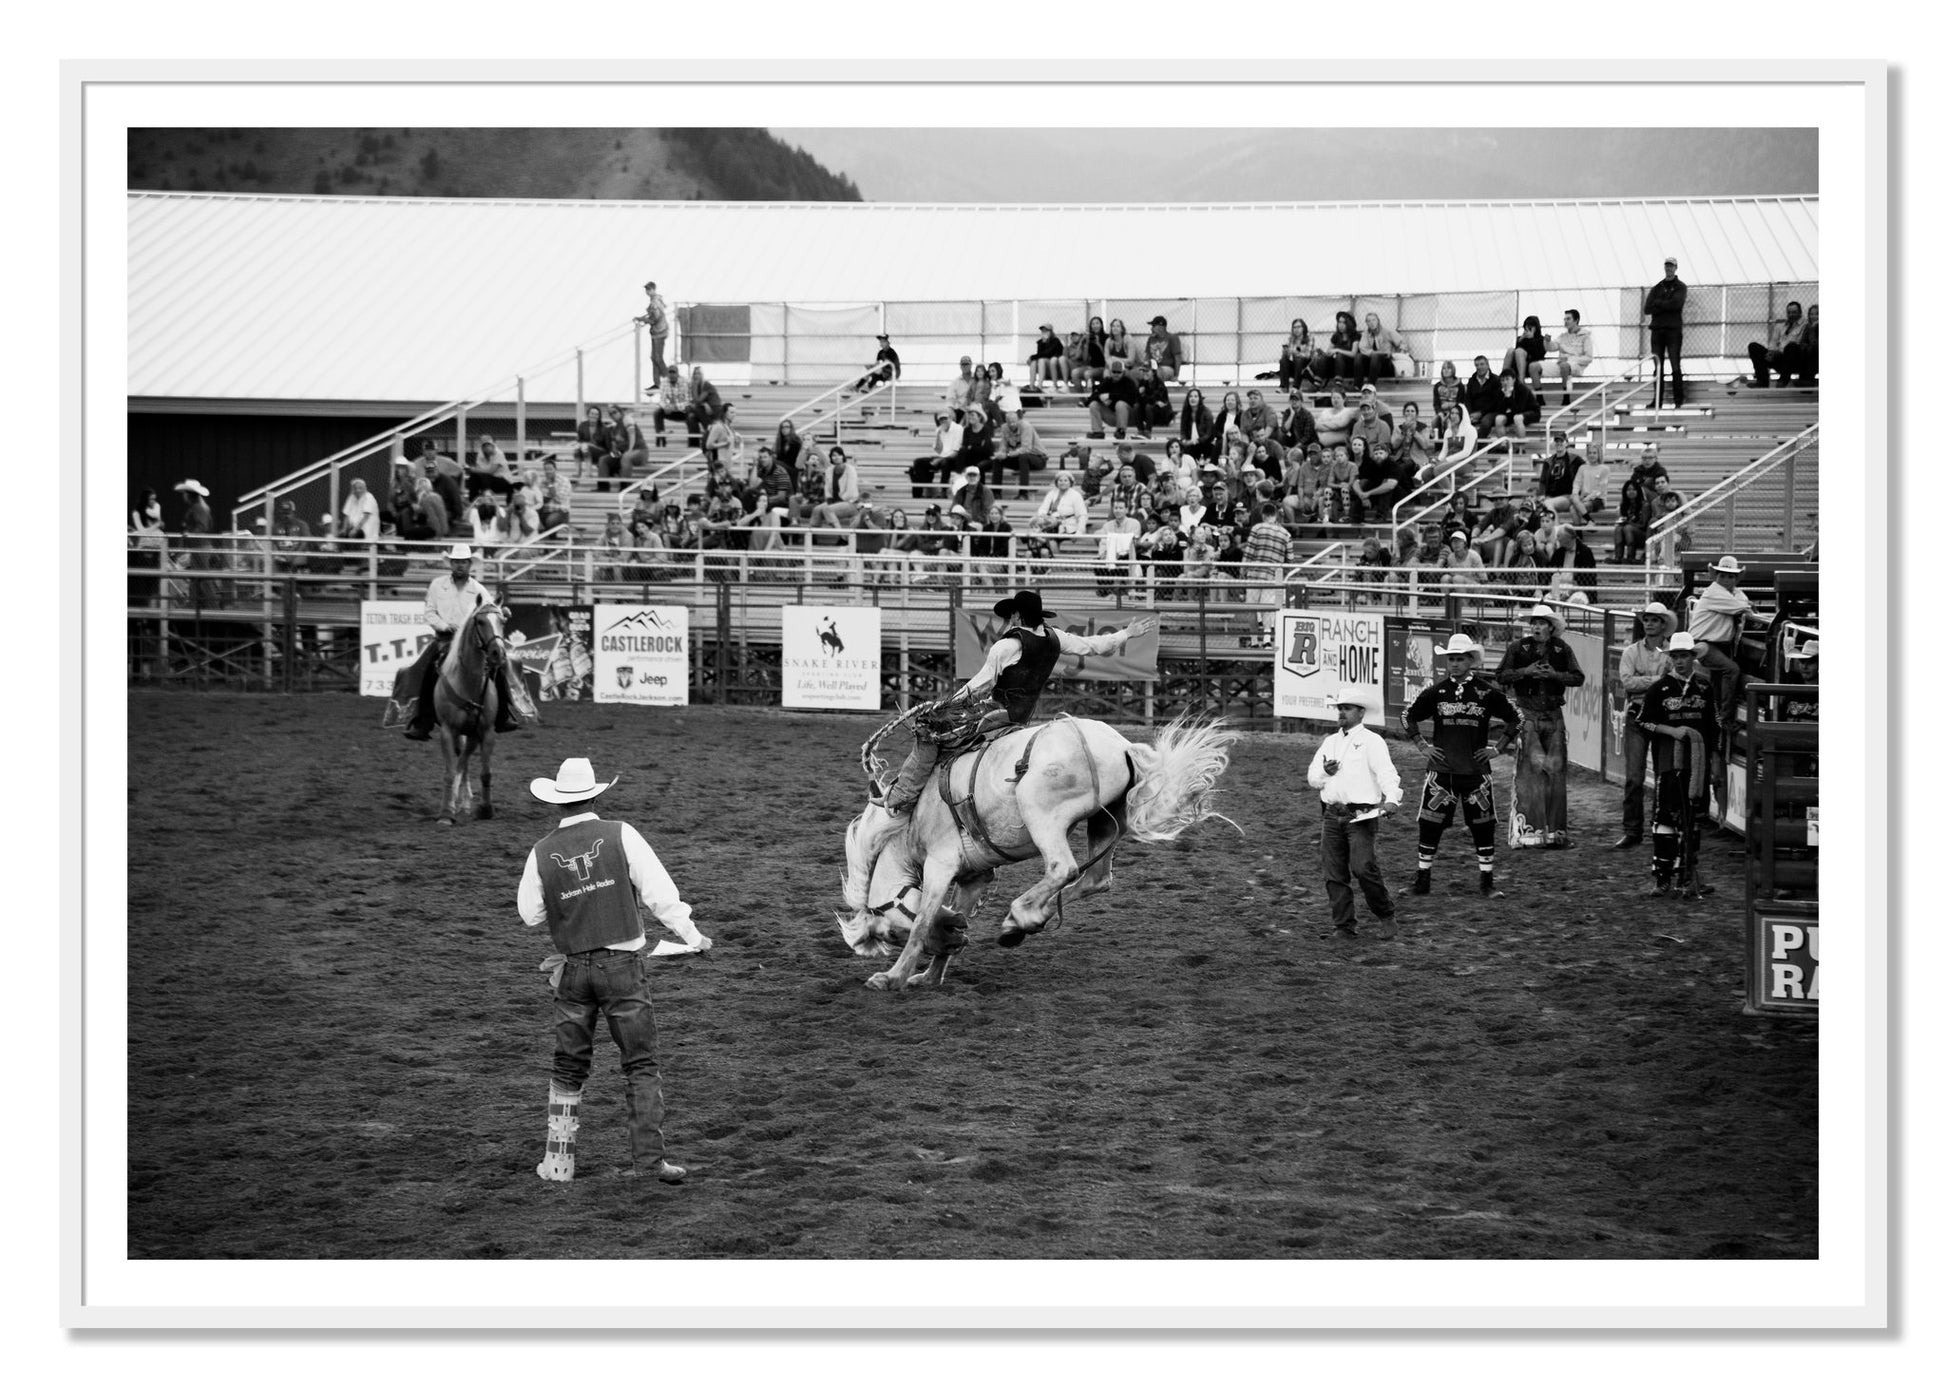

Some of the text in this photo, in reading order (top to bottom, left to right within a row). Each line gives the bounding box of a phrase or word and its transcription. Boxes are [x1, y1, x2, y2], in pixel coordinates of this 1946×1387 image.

[1321, 617, 1379, 645] RANCH
[601, 634, 683, 653] CASTLEROCK
[1287, 632, 1317, 666] R
[783, 658, 878, 670] SNAKE RIVER
[1339, 643, 1379, 685] HOME
[639, 672, 668, 688] Jeep
[818, 680, 838, 690] Well
[838, 681, 868, 693] Played
[560, 878, 615, 900] Jackson Hole Rodeo
